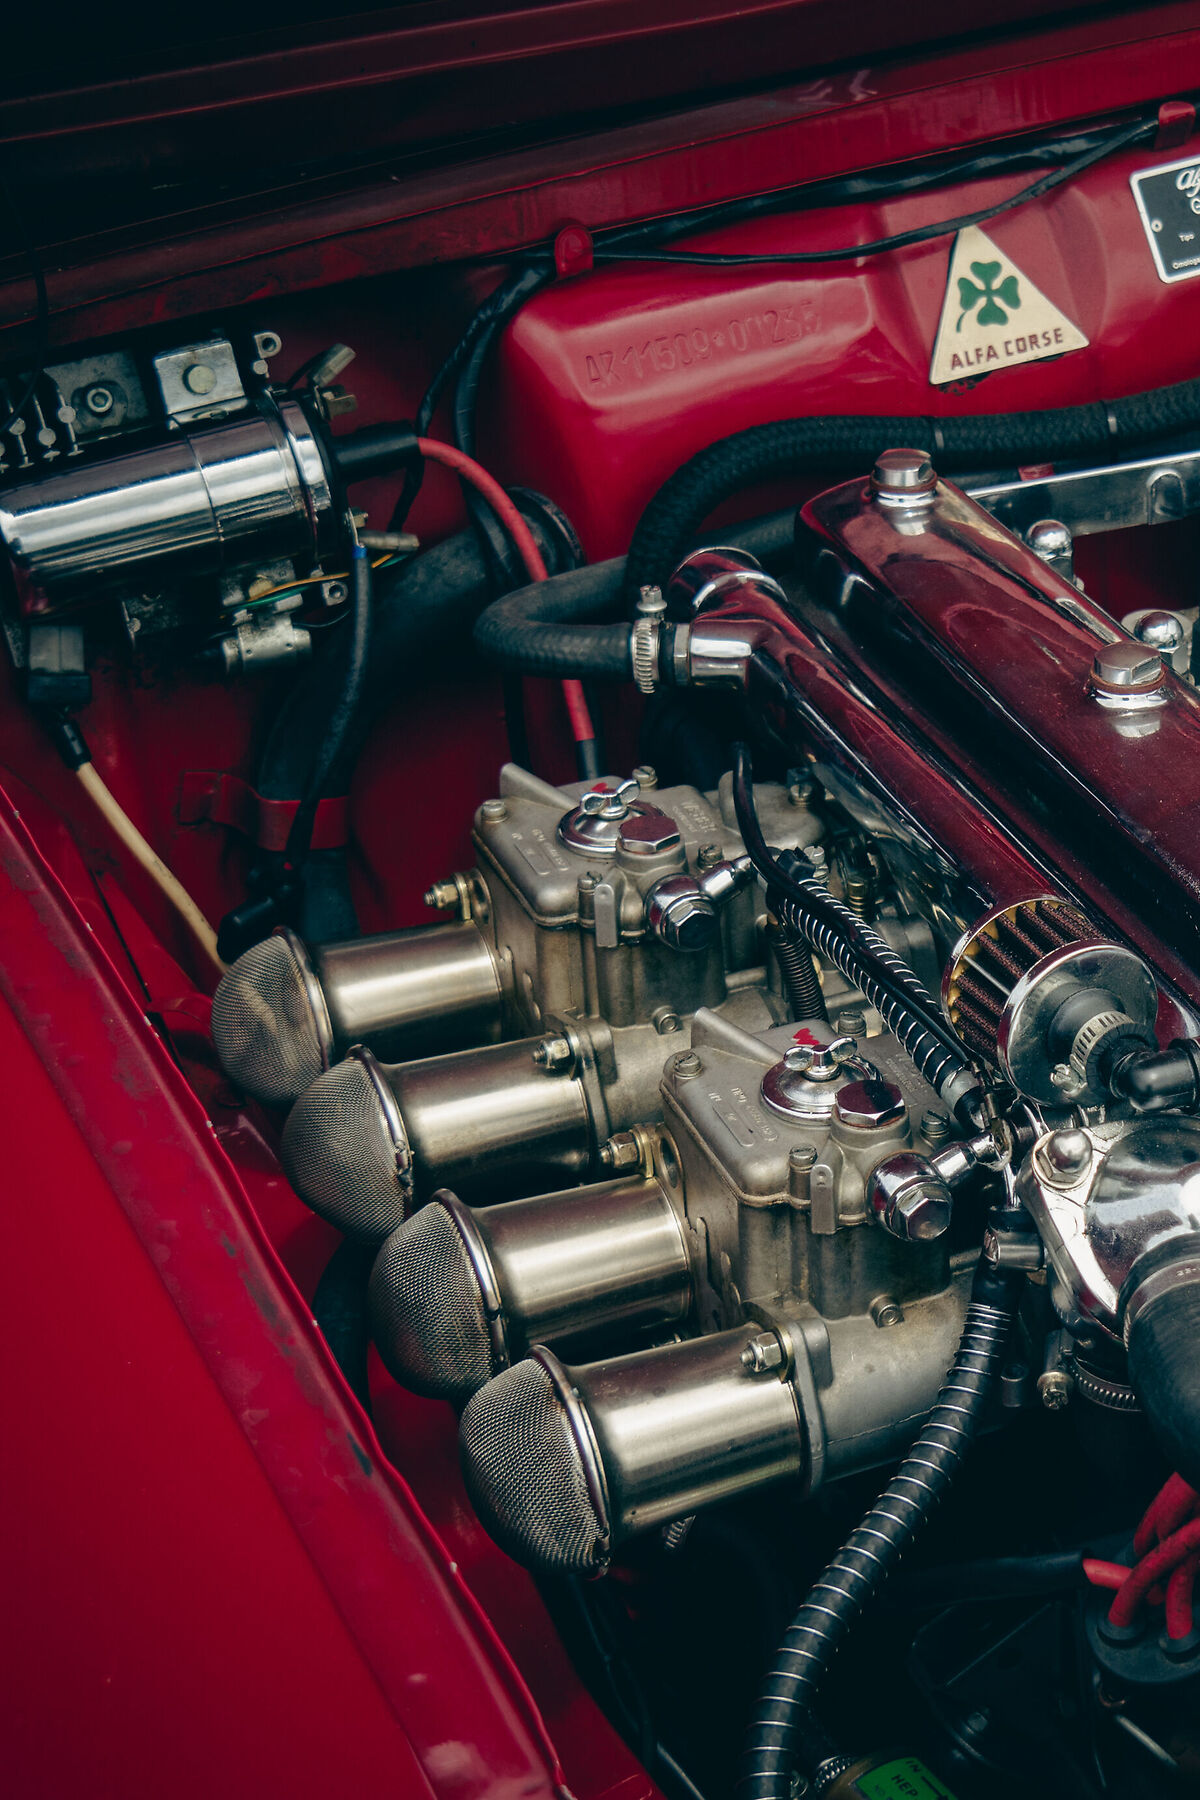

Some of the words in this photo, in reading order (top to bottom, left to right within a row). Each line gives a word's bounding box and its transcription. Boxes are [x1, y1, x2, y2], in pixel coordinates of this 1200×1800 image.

[950, 345, 999, 371] ALFA
[1004, 327, 1064, 357] CORSE
[904, 1760, 922, 1773] IN
